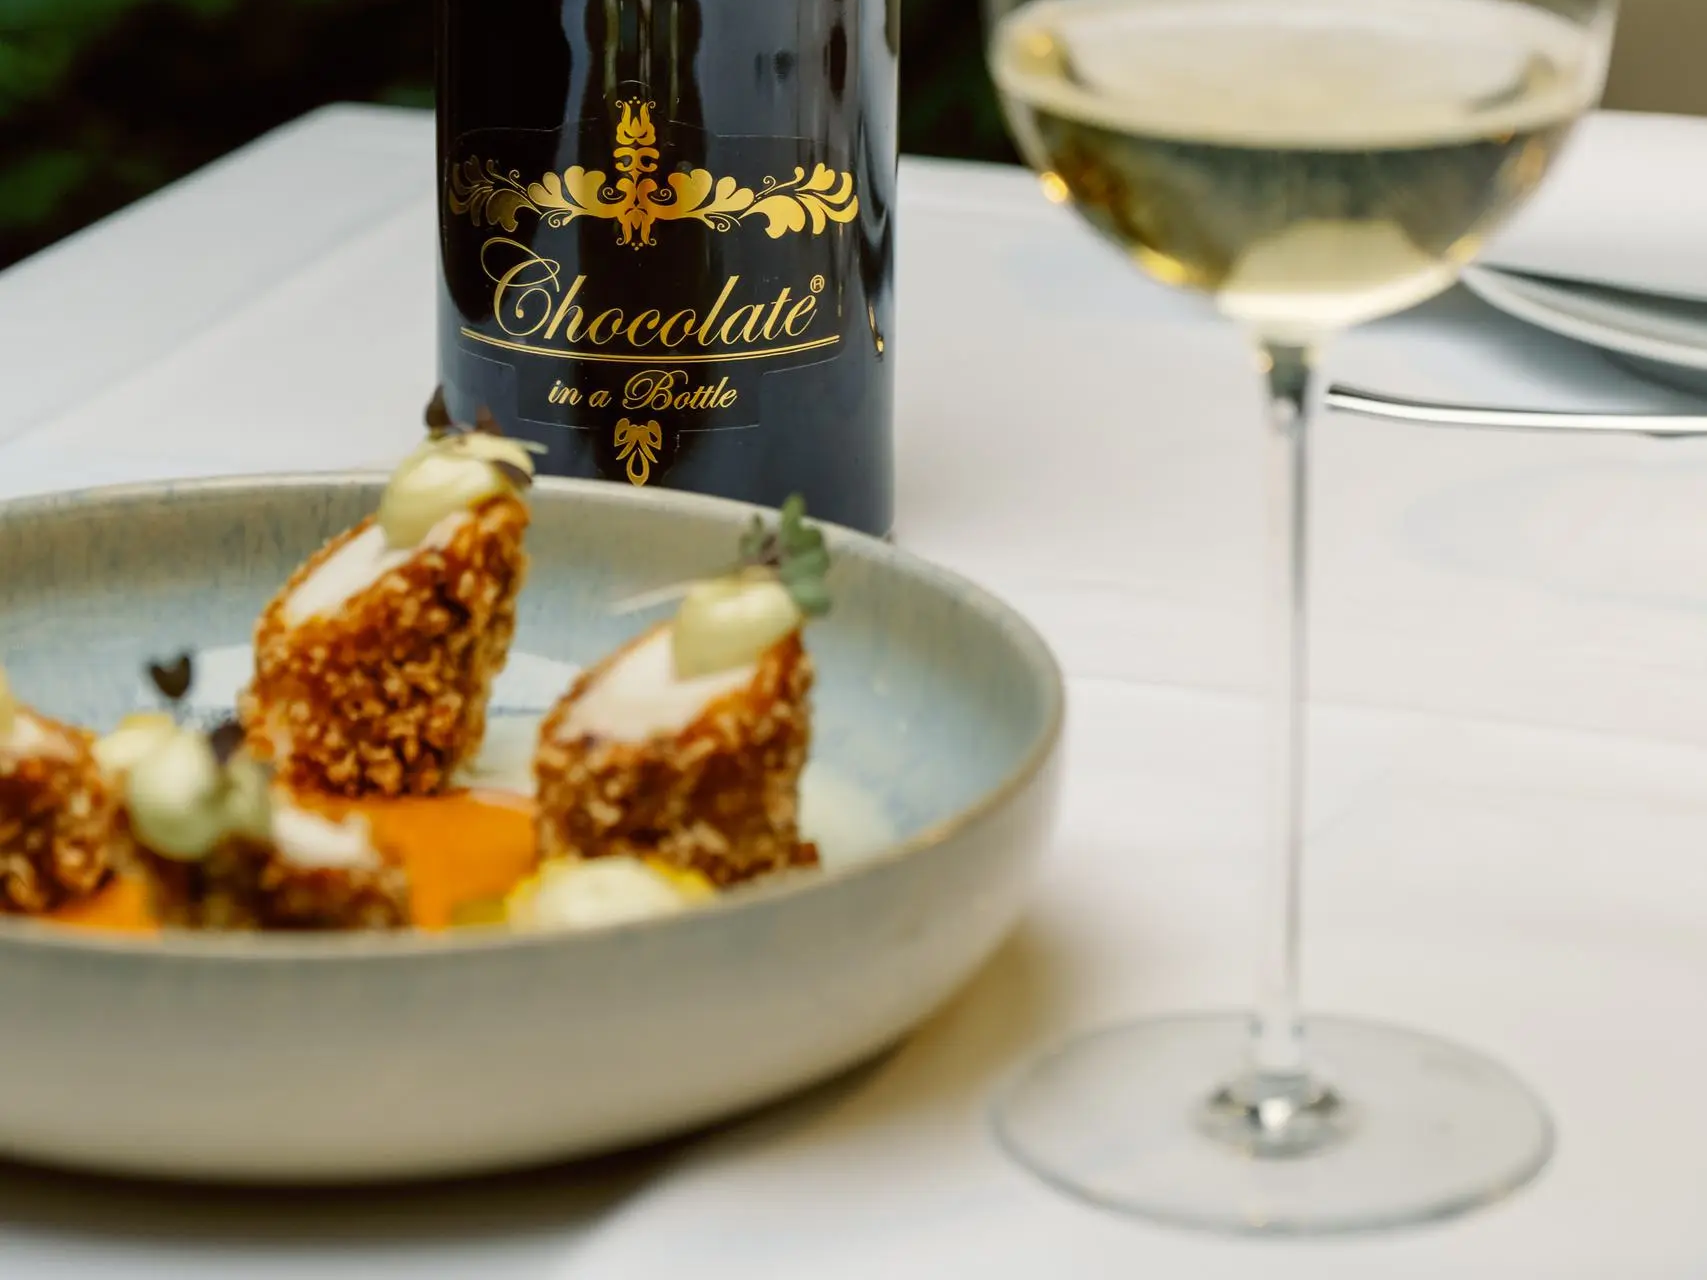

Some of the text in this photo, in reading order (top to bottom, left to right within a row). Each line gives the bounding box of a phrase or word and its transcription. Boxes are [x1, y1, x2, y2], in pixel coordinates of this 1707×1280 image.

[547, 369, 738, 411] in a Bottle
